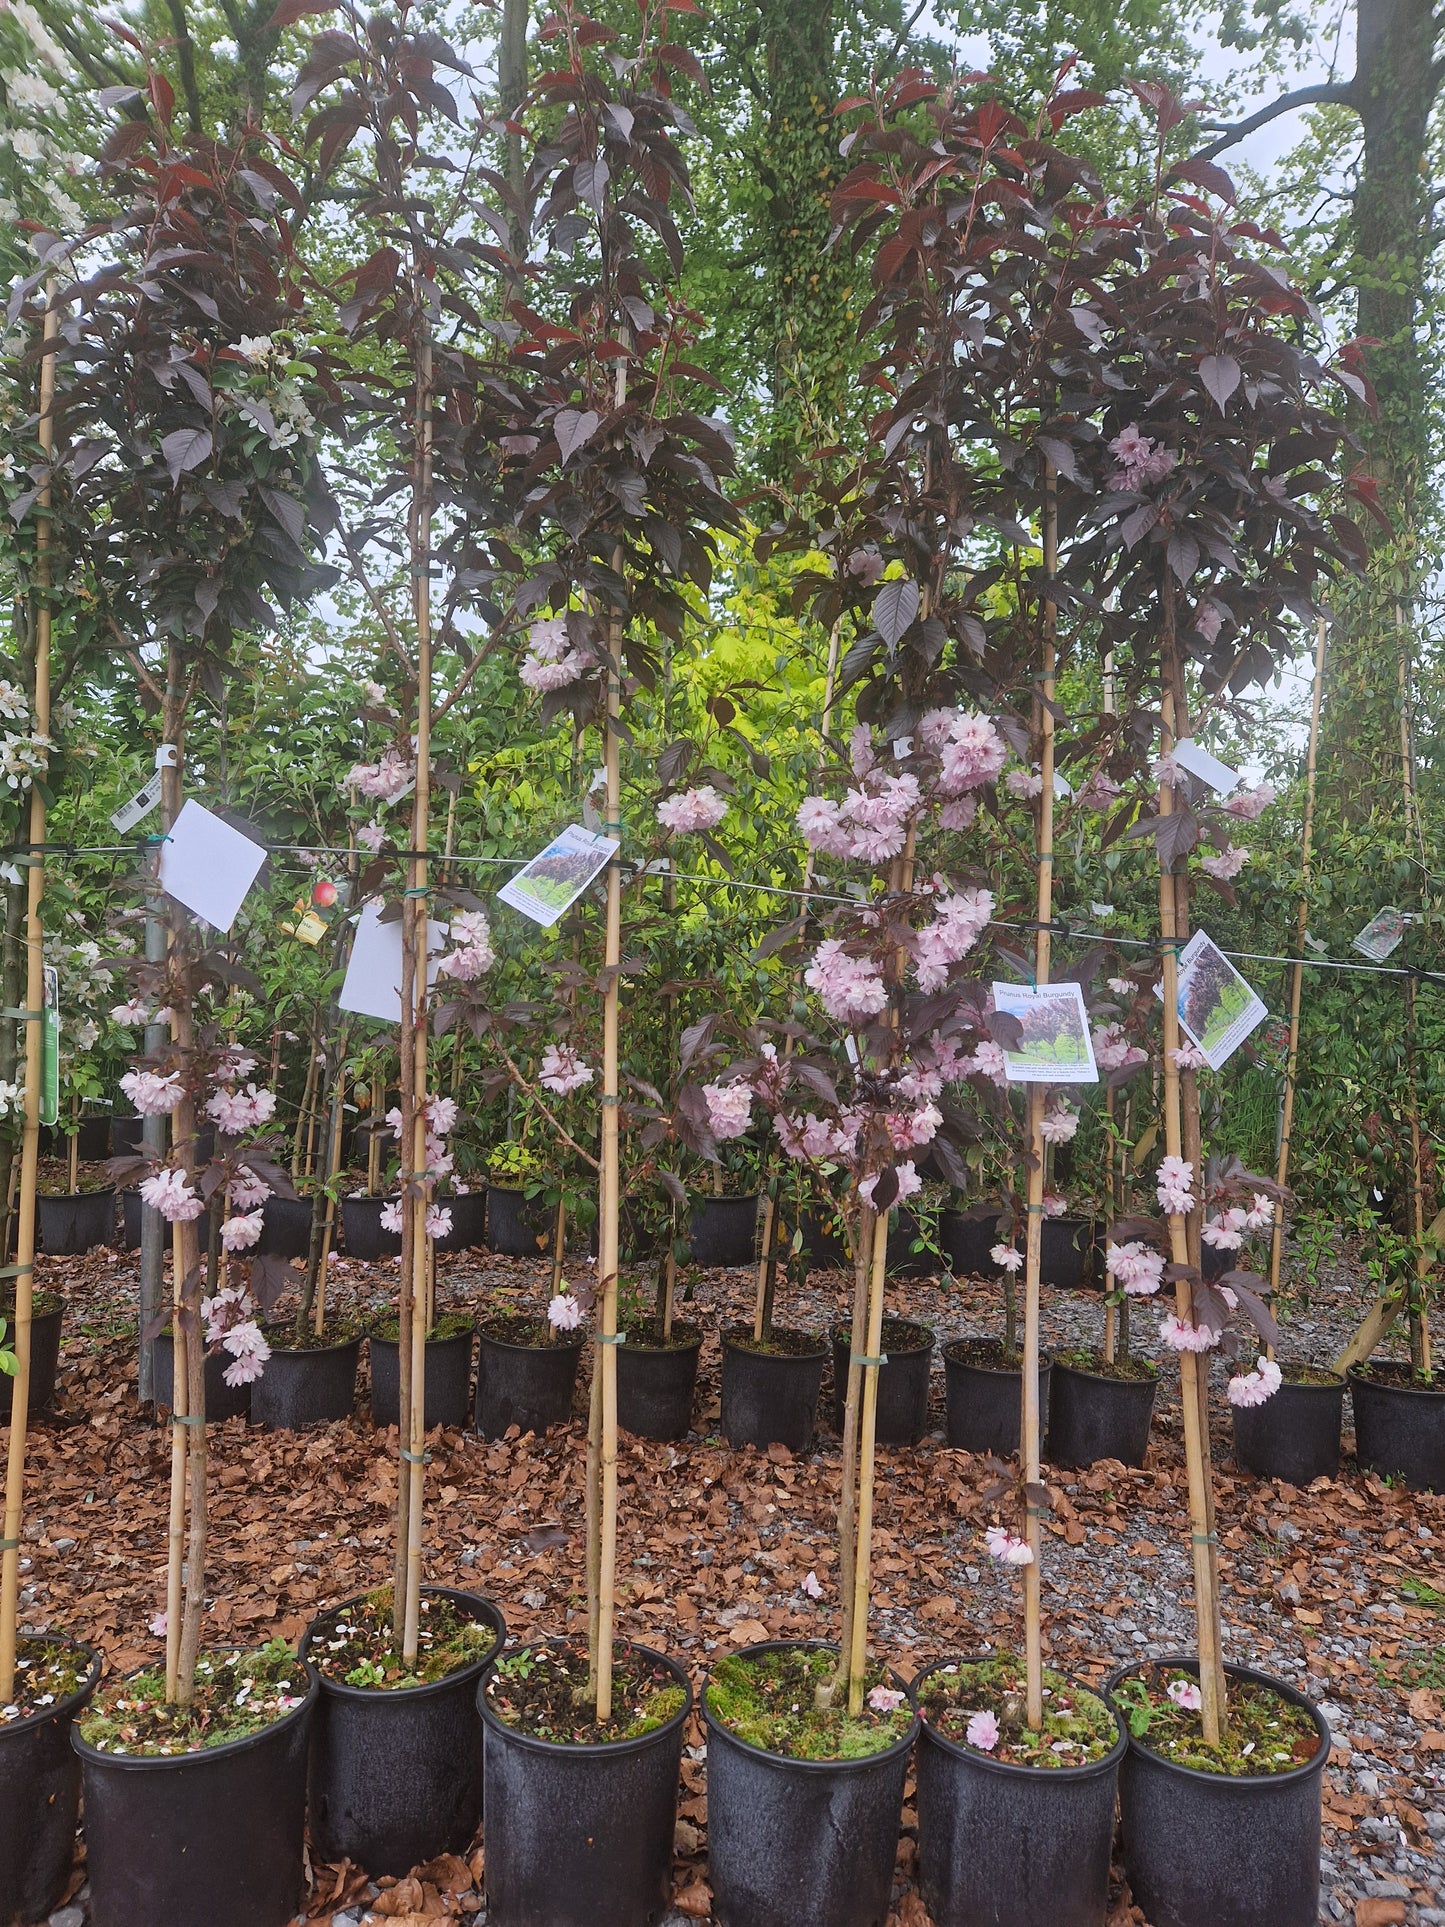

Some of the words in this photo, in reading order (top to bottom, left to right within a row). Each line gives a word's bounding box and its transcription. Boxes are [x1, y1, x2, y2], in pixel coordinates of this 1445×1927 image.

[999, 989, 1021, 998] Prunus
[1022, 992, 1042, 1000] Royal
[1042, 990, 1075, 999] Burgundy
